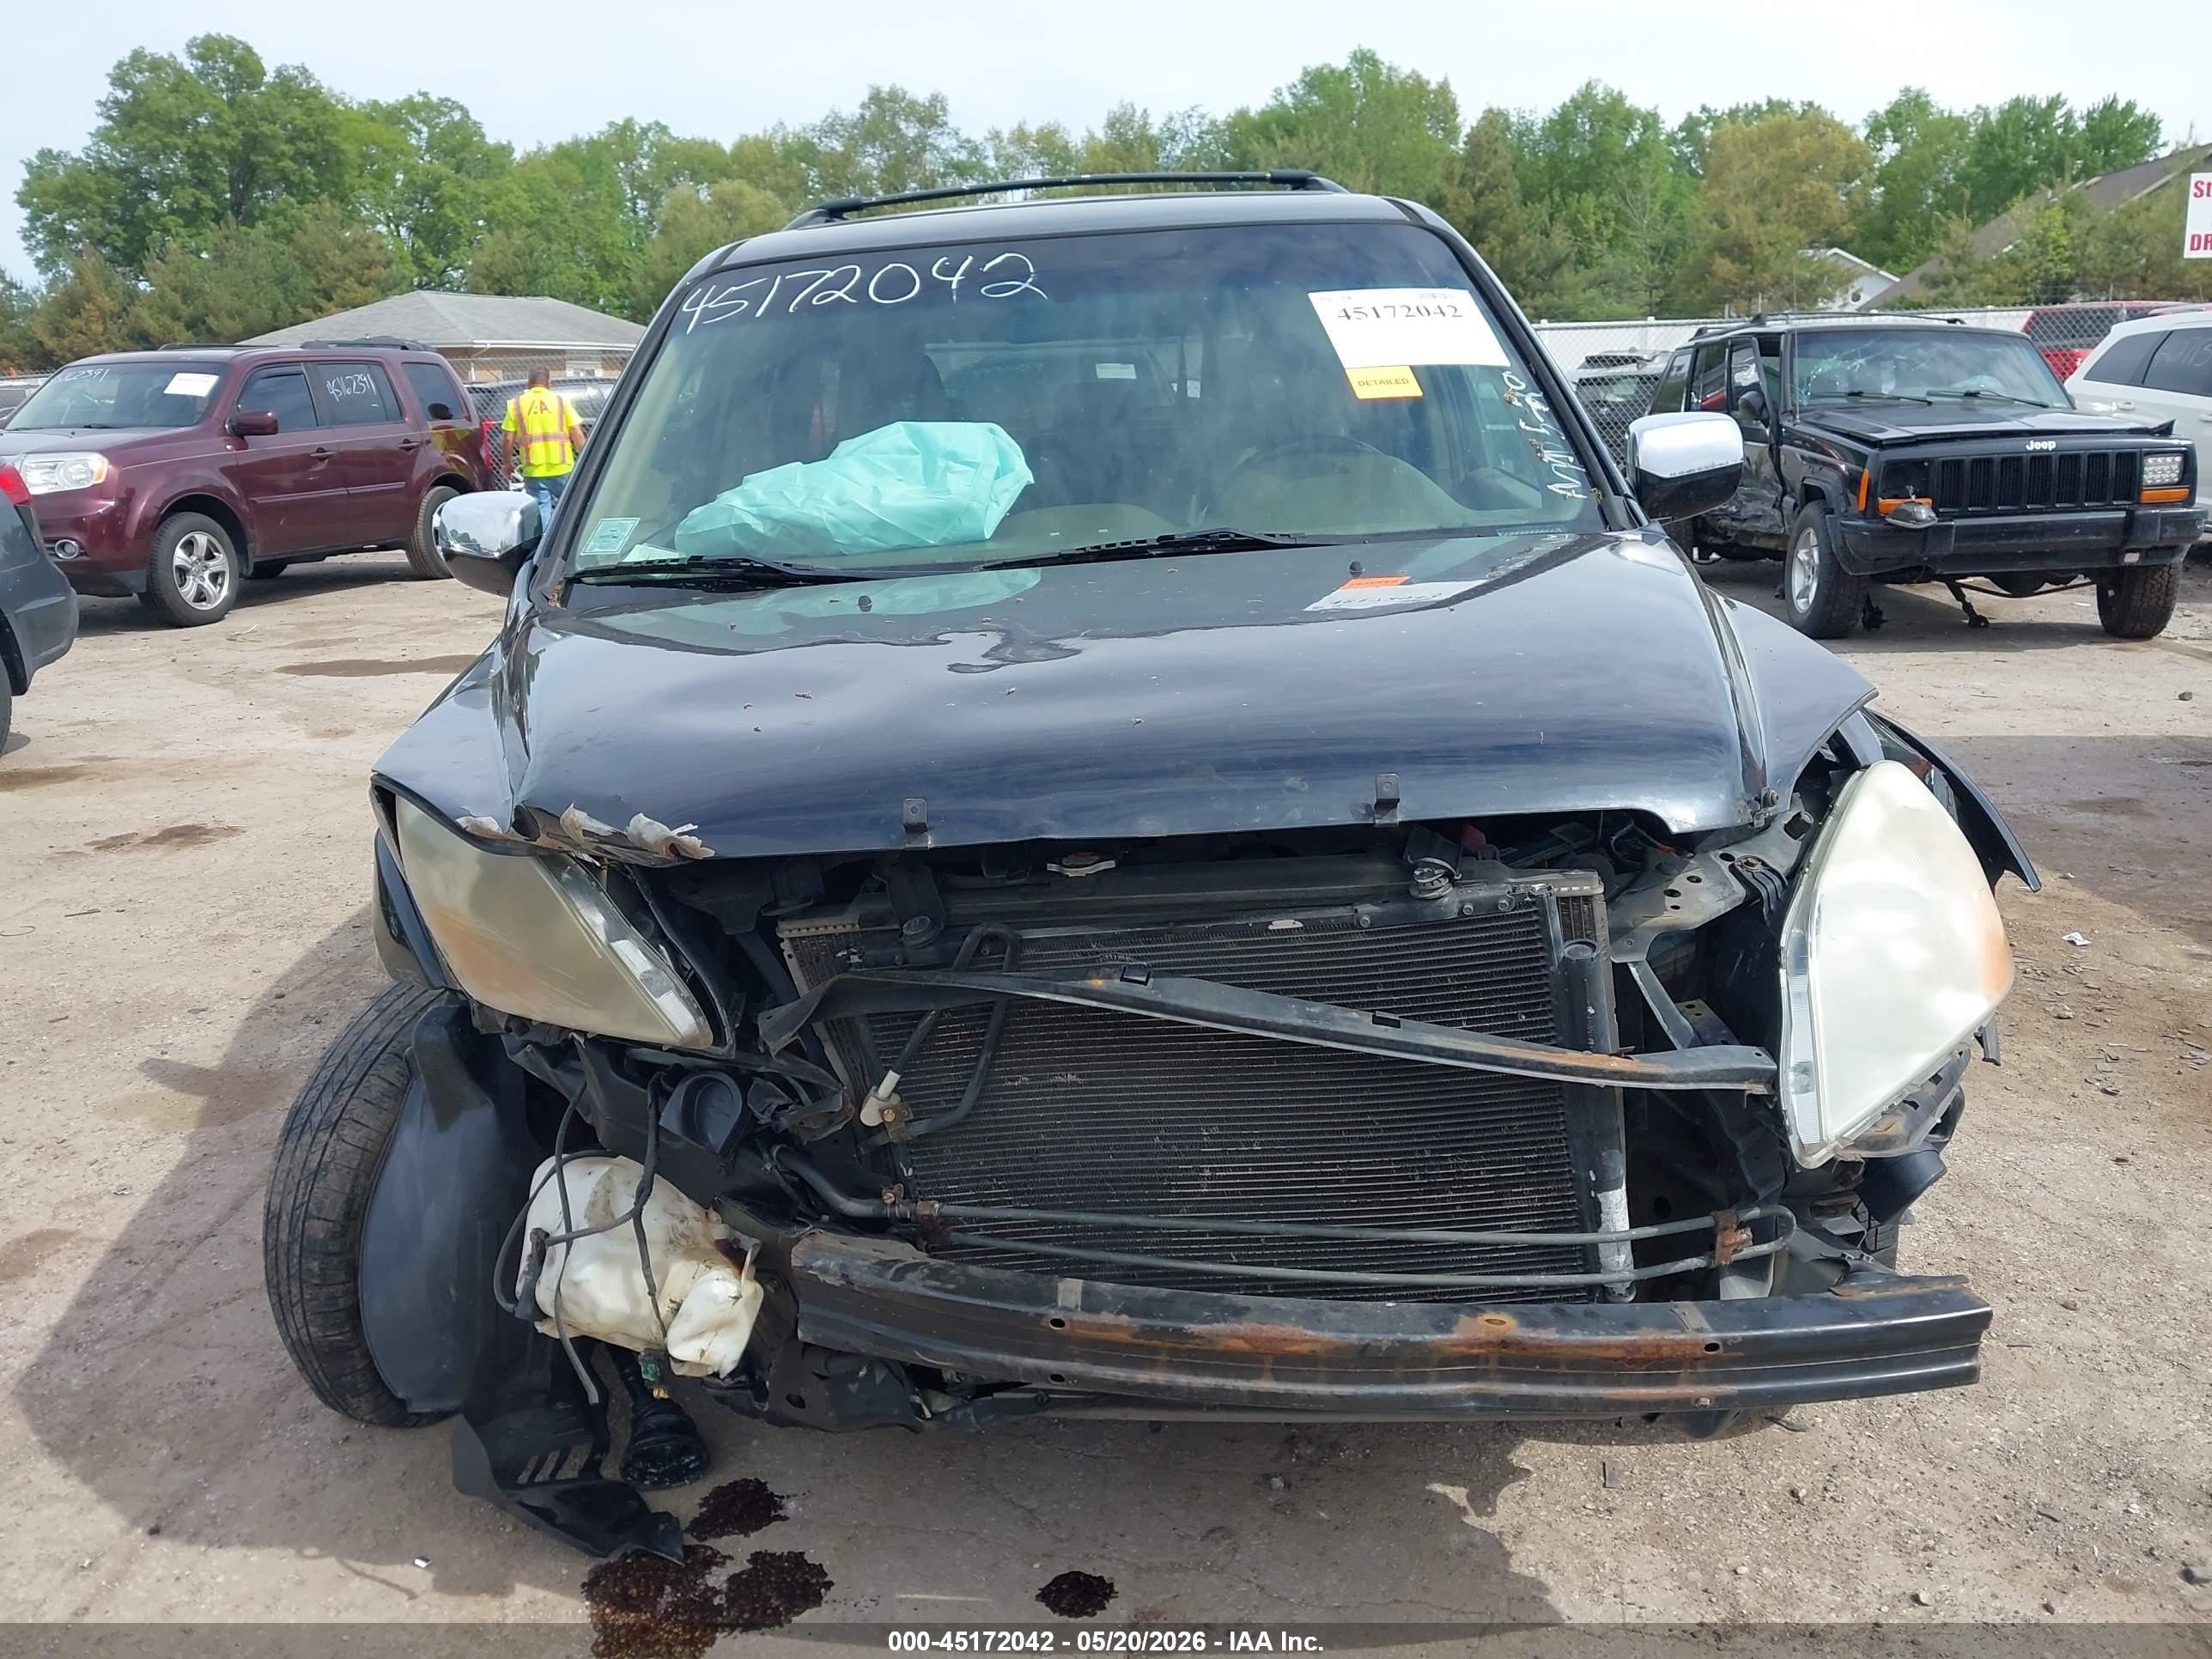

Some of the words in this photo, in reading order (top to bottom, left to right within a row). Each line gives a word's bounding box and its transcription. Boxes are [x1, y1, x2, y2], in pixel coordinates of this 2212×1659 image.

[681, 252, 1049, 335] 45172042
[1337, 304, 1464, 320] 45172042
[1357, 377, 1410, 387] DETAILED
[2025, 440, 2057, 452] Jeep
